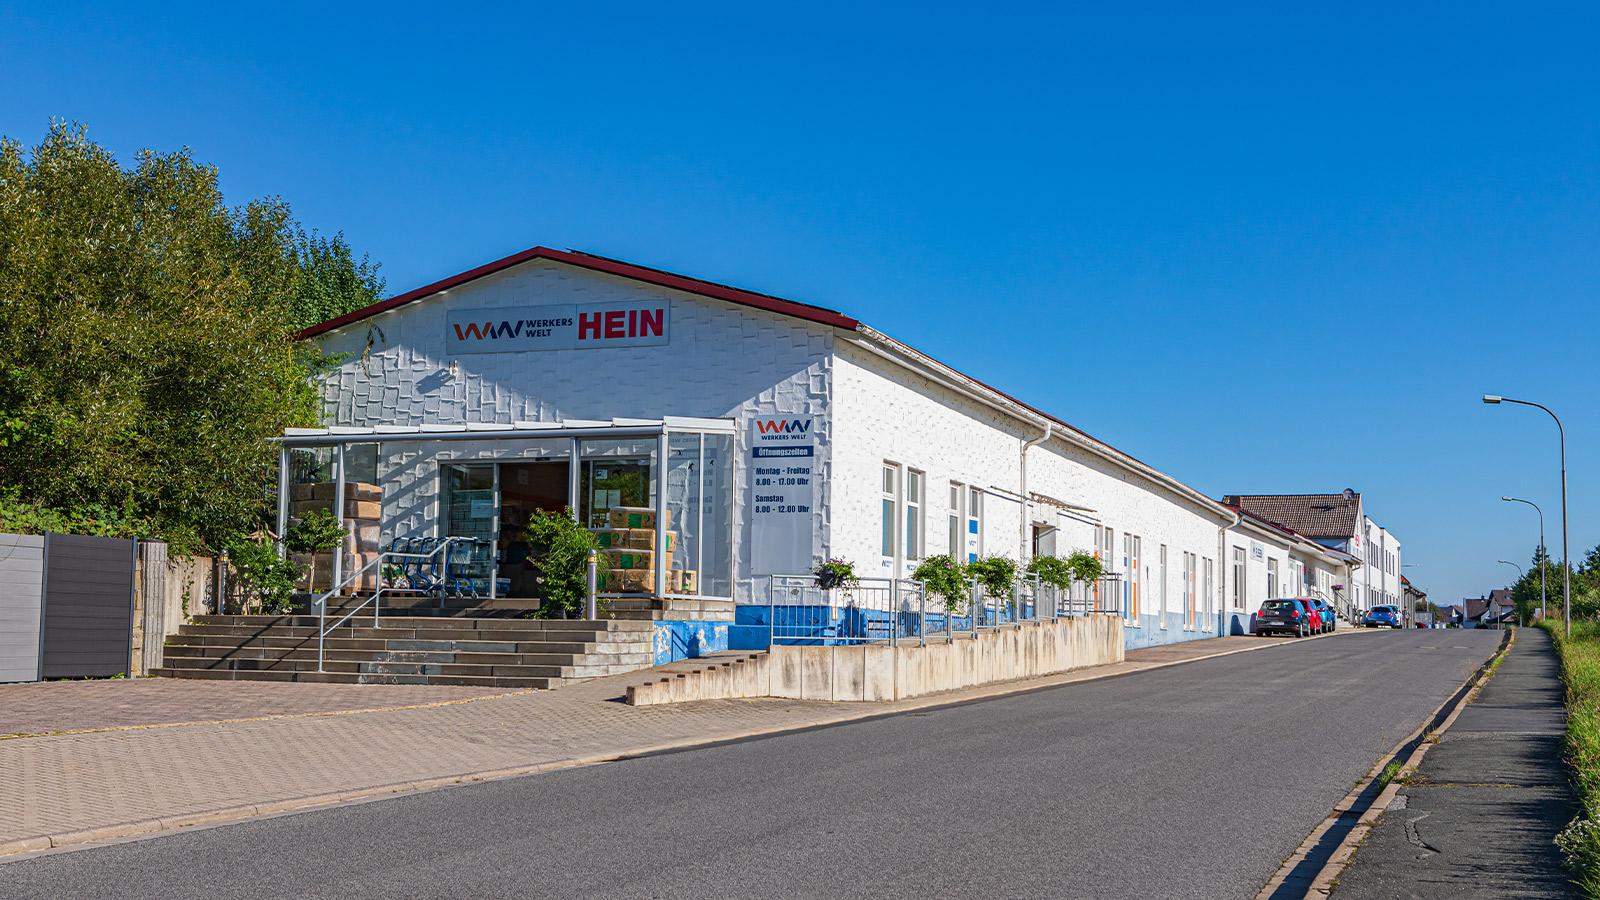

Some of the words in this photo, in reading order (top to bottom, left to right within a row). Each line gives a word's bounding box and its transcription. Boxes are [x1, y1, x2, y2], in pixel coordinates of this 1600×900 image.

[525, 318, 573, 329] WERKERS
[578, 308, 664, 340] HEIN
[525, 328, 552, 338] WELT
[758, 447, 808, 457] Öffnungszeiten
[755, 467, 780, 475] Montag
[787, 467, 810, 475] Freitag
[755, 478, 770, 486] 8.00
[778, 477, 795, 486] 17.00
[797, 477, 809, 485] Uhr
[755, 494, 784, 503] Samstag
[755, 505, 770, 513] 8.00
[778, 505, 796, 513] 12.00
[797, 505, 810, 513] Uhr
